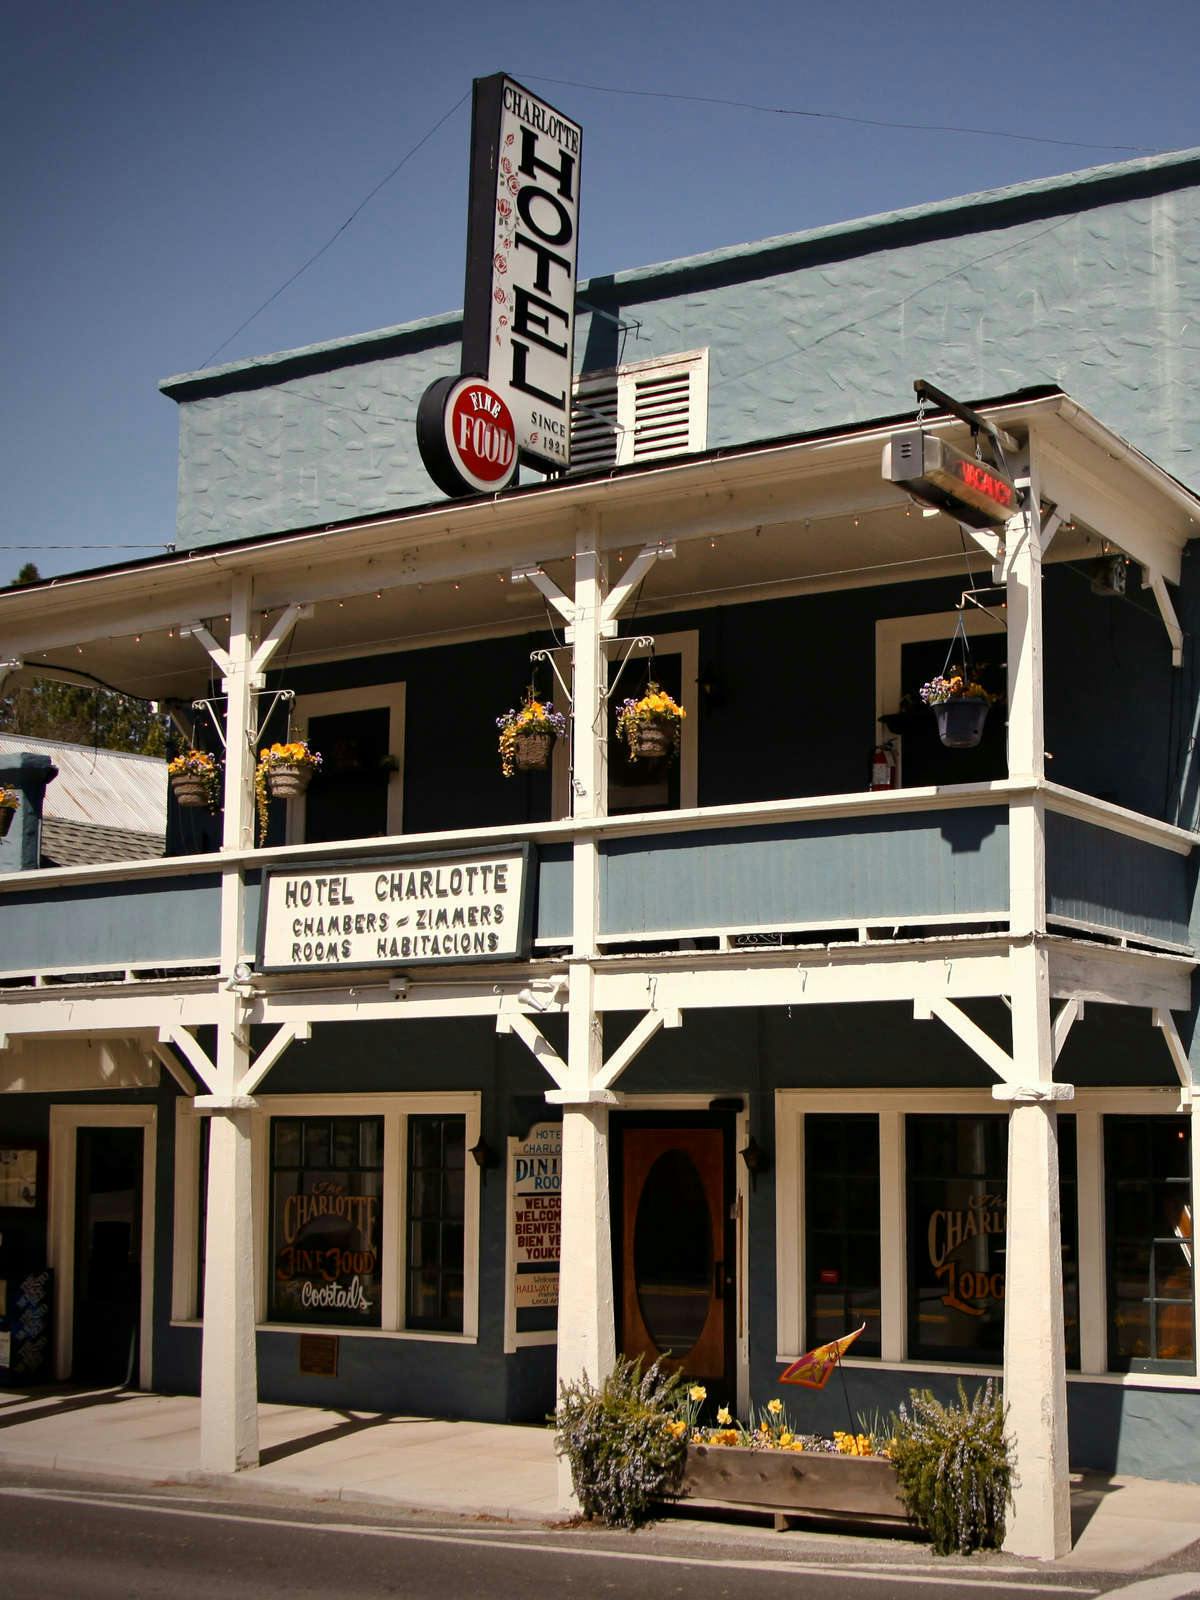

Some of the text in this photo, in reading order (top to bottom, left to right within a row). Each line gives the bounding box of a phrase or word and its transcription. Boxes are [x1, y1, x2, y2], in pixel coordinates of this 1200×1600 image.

[503, 86, 579, 154] CHARLOTTE
[509, 124, 576, 411] HOTEL
[469, 391, 502, 419] FINE
[531, 411, 566, 438] SINCE
[458, 411, 513, 467] FOOD
[543, 437, 566, 457] 1921
[285, 863, 508, 908] HOTEL CHARLOTTE
[292, 912, 390, 937] CHAMBERS
[416, 904, 504, 930] ZIMMERS
[291, 932, 499, 963] ROOMS HABITACIONS
[523, 1143, 562, 1154] CHARLO
[536, 1130, 561, 1140] HOTE
[516, 1158, 561, 1182] DINI
[535, 1175, 561, 1190] ROO
[515, 1210, 561, 1222] WELCOM
[525, 1198, 561, 1210] WELCO
[283, 1193, 378, 1248] CHARLOTTE
[515, 1222, 561, 1235] BIENVEN
[518, 1234, 561, 1248] BIEN VE
[928, 1210, 1006, 1268] CHARL
[526, 1248, 560, 1259] YOUKO
[301, 1275, 373, 1310] Cocktails
[935, 1263, 1005, 1317] LODG
